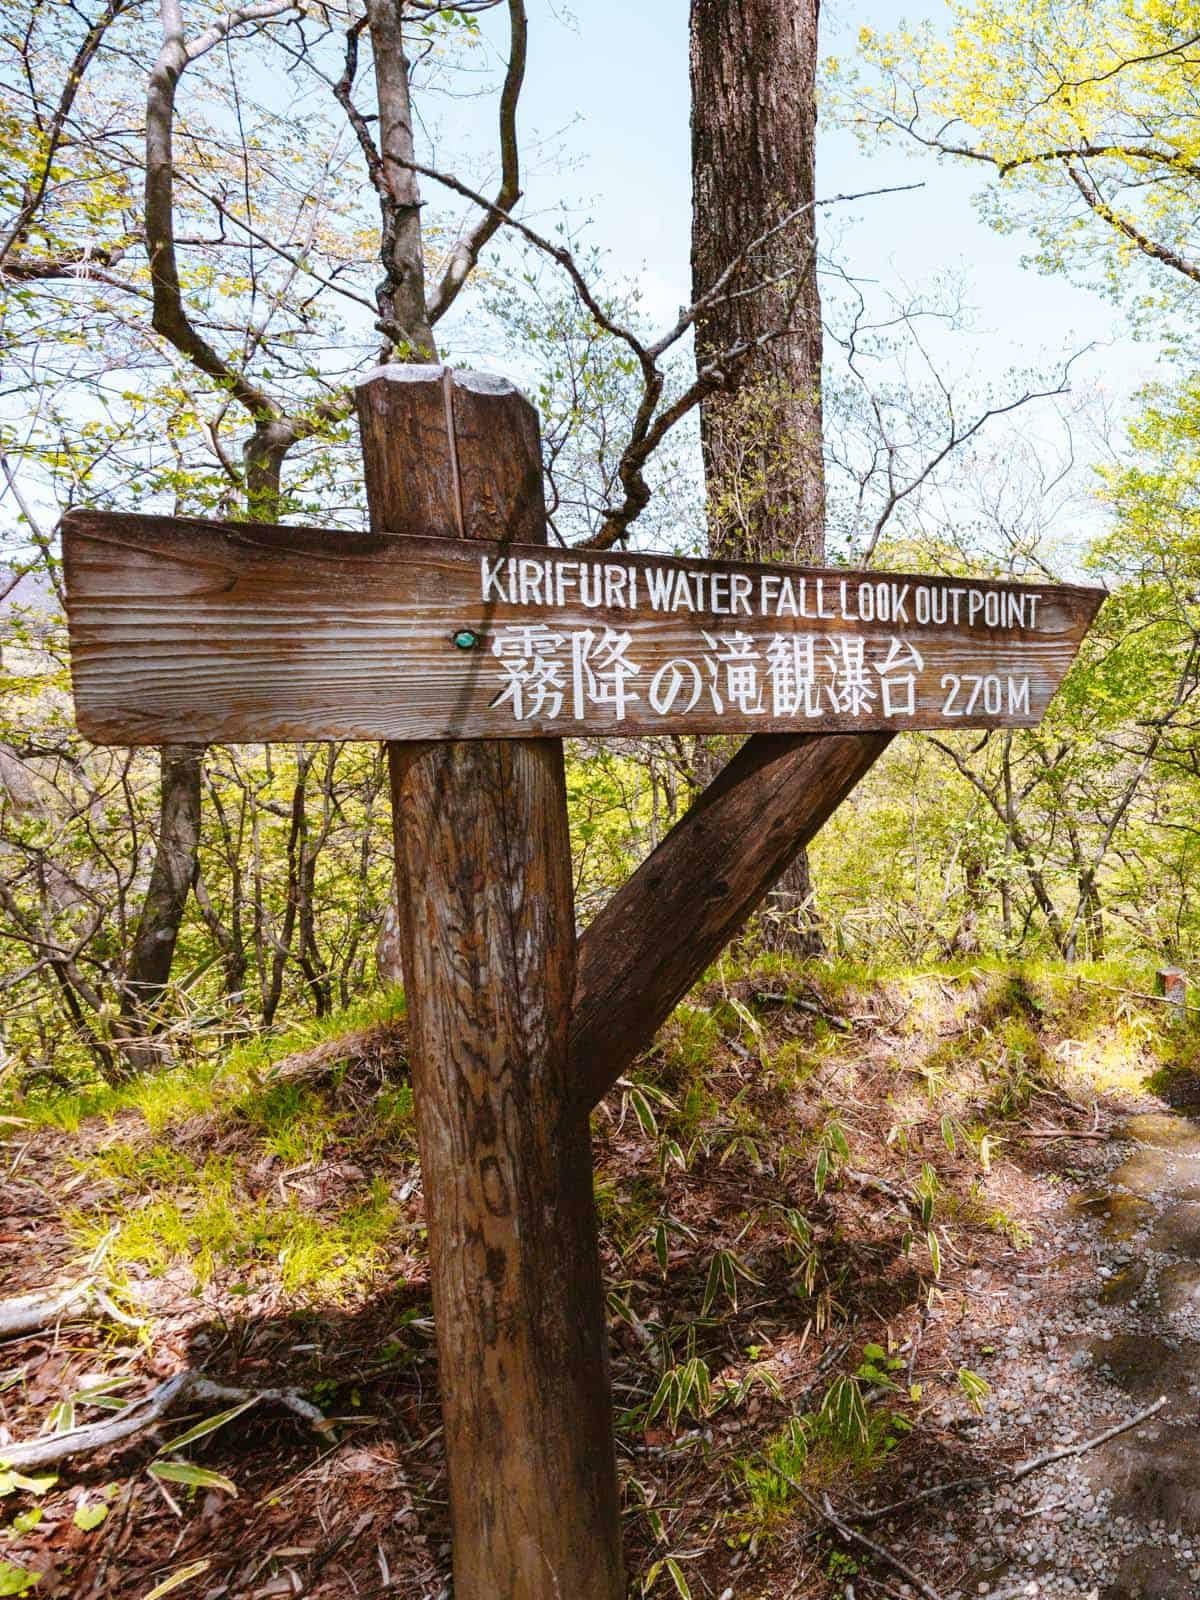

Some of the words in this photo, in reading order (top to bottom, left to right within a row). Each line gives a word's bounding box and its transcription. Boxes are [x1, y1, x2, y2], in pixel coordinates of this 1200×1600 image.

[480, 556, 638, 610] KIRIFURI
[488, 623, 925, 721] 霧降の滝観瀑台
[940, 673, 1031, 717] 270M
